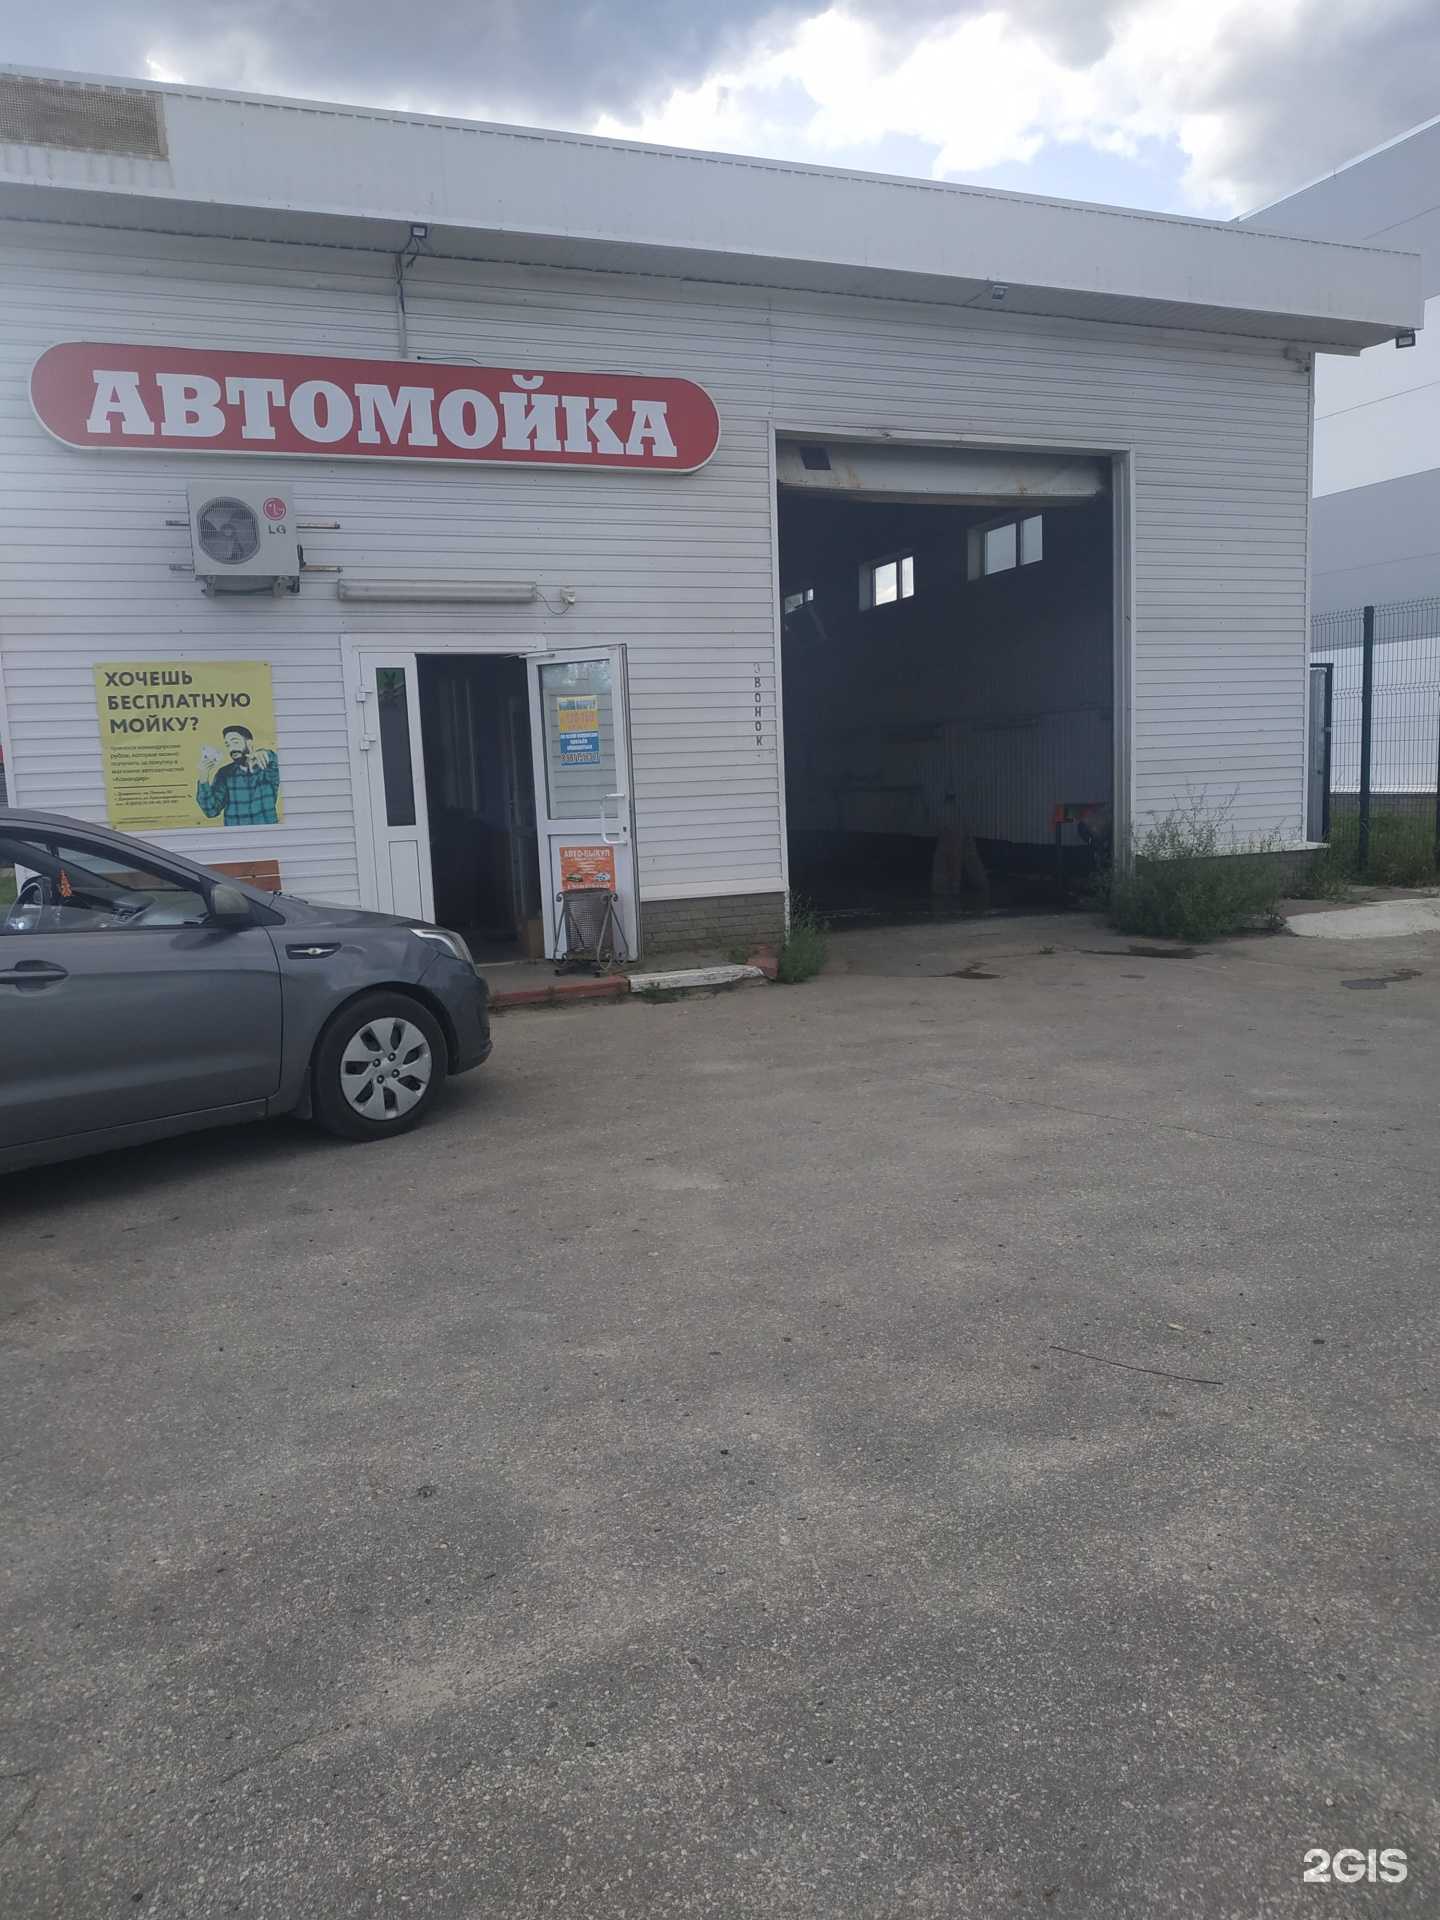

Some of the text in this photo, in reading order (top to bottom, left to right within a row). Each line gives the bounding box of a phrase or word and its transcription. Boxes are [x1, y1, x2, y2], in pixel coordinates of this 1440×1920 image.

[86, 369, 678, 457] АВТОМОЙКА
[268, 524, 286, 535] LG
[104, 670, 193, 687] ХОЧЕШЬ
[107, 692, 251, 710] БЕСПЛАТНУЮ
[109, 714, 199, 734] МОЙКУ?
